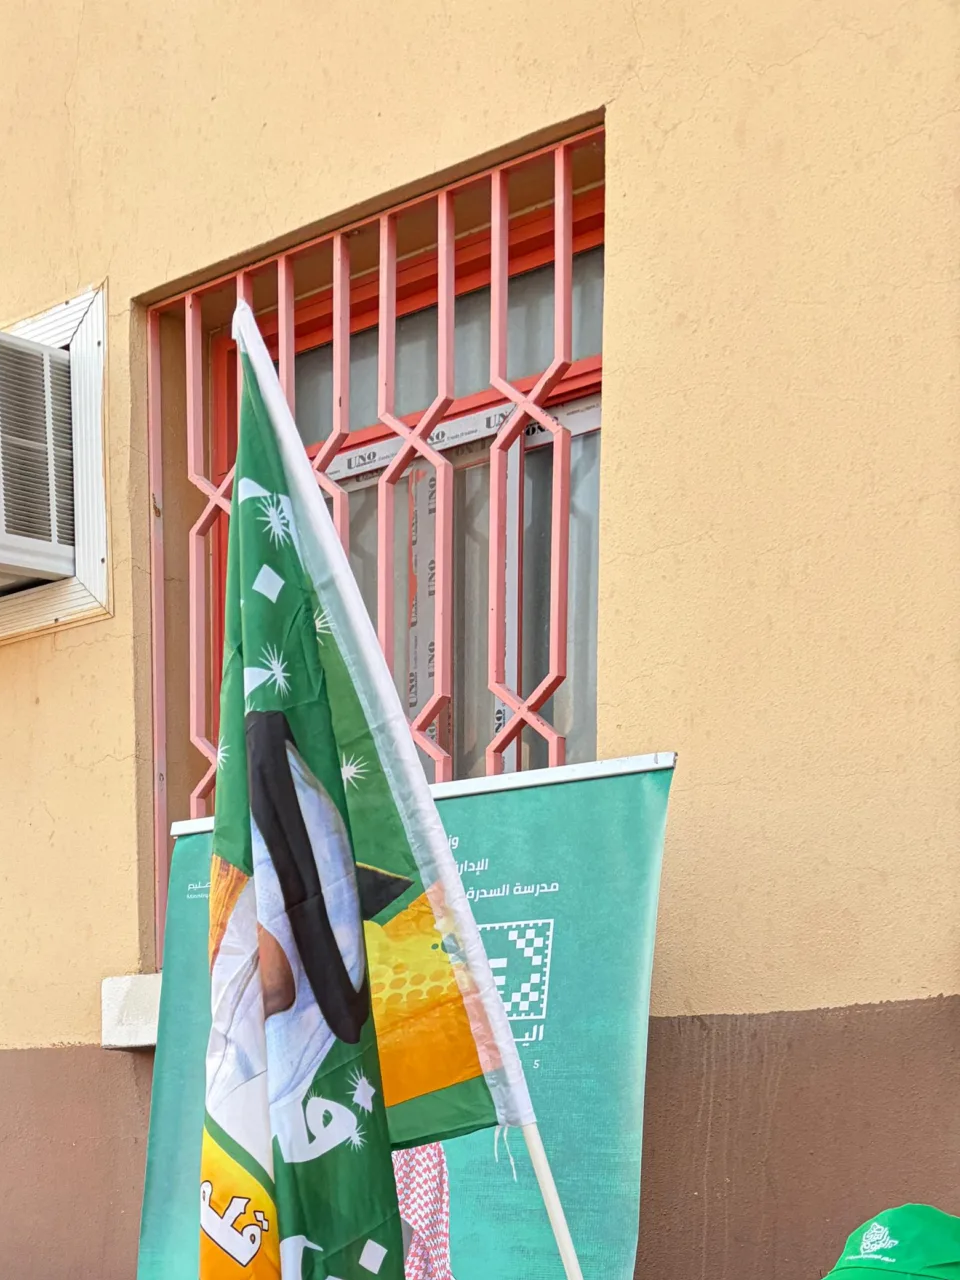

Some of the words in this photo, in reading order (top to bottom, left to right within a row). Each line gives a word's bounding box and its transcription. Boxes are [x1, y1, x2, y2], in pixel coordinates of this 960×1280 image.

[346, 451, 377, 470] UNO
[466, 884, 510, 901] السدرة
[513, 880, 559, 896] مدرسة
